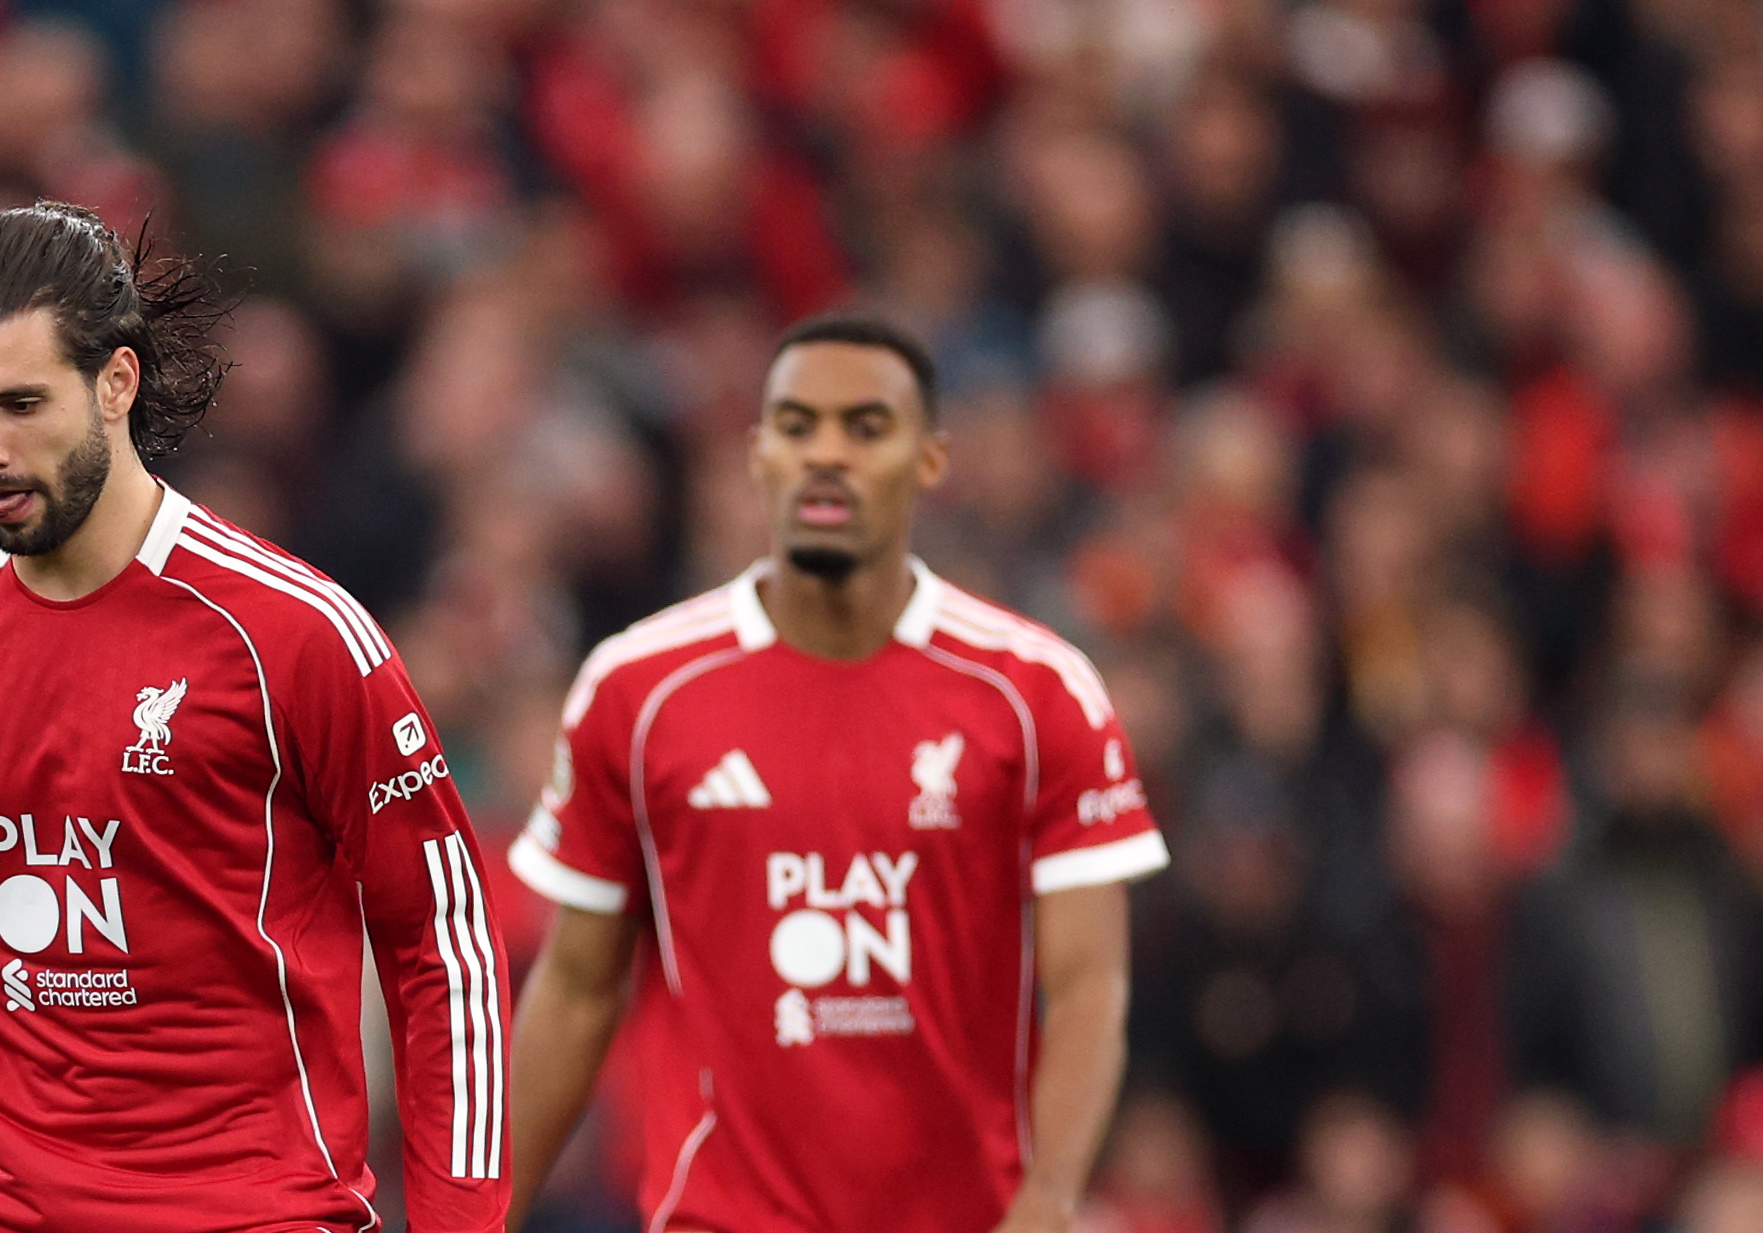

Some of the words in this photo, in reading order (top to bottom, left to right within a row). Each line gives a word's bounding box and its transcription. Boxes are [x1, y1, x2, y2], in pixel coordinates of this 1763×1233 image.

[121, 752, 175, 775] L.F.C.
[766, 851, 919, 910] PLAY
[769, 908, 913, 987] ON
[36, 969, 128, 989] standard
[39, 988, 138, 1007] chartered
